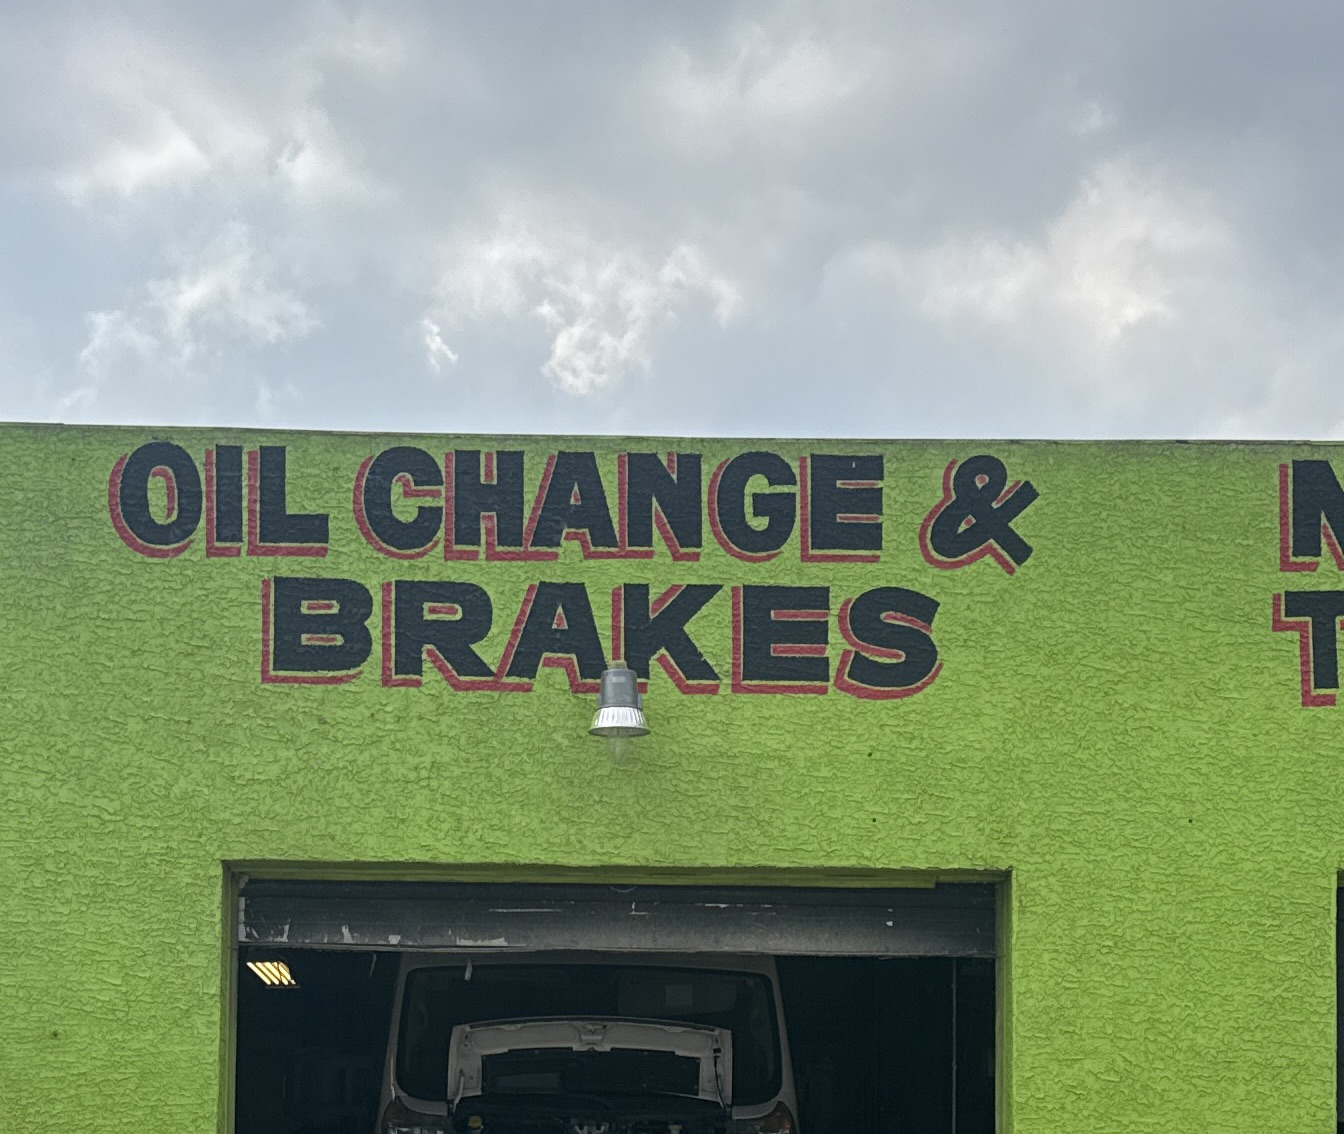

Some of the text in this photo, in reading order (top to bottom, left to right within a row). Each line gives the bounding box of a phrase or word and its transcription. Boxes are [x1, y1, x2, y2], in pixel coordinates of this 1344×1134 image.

[109, 440, 1039, 574] OIL CHANGE &
[260, 575, 942, 700] BRAKES
